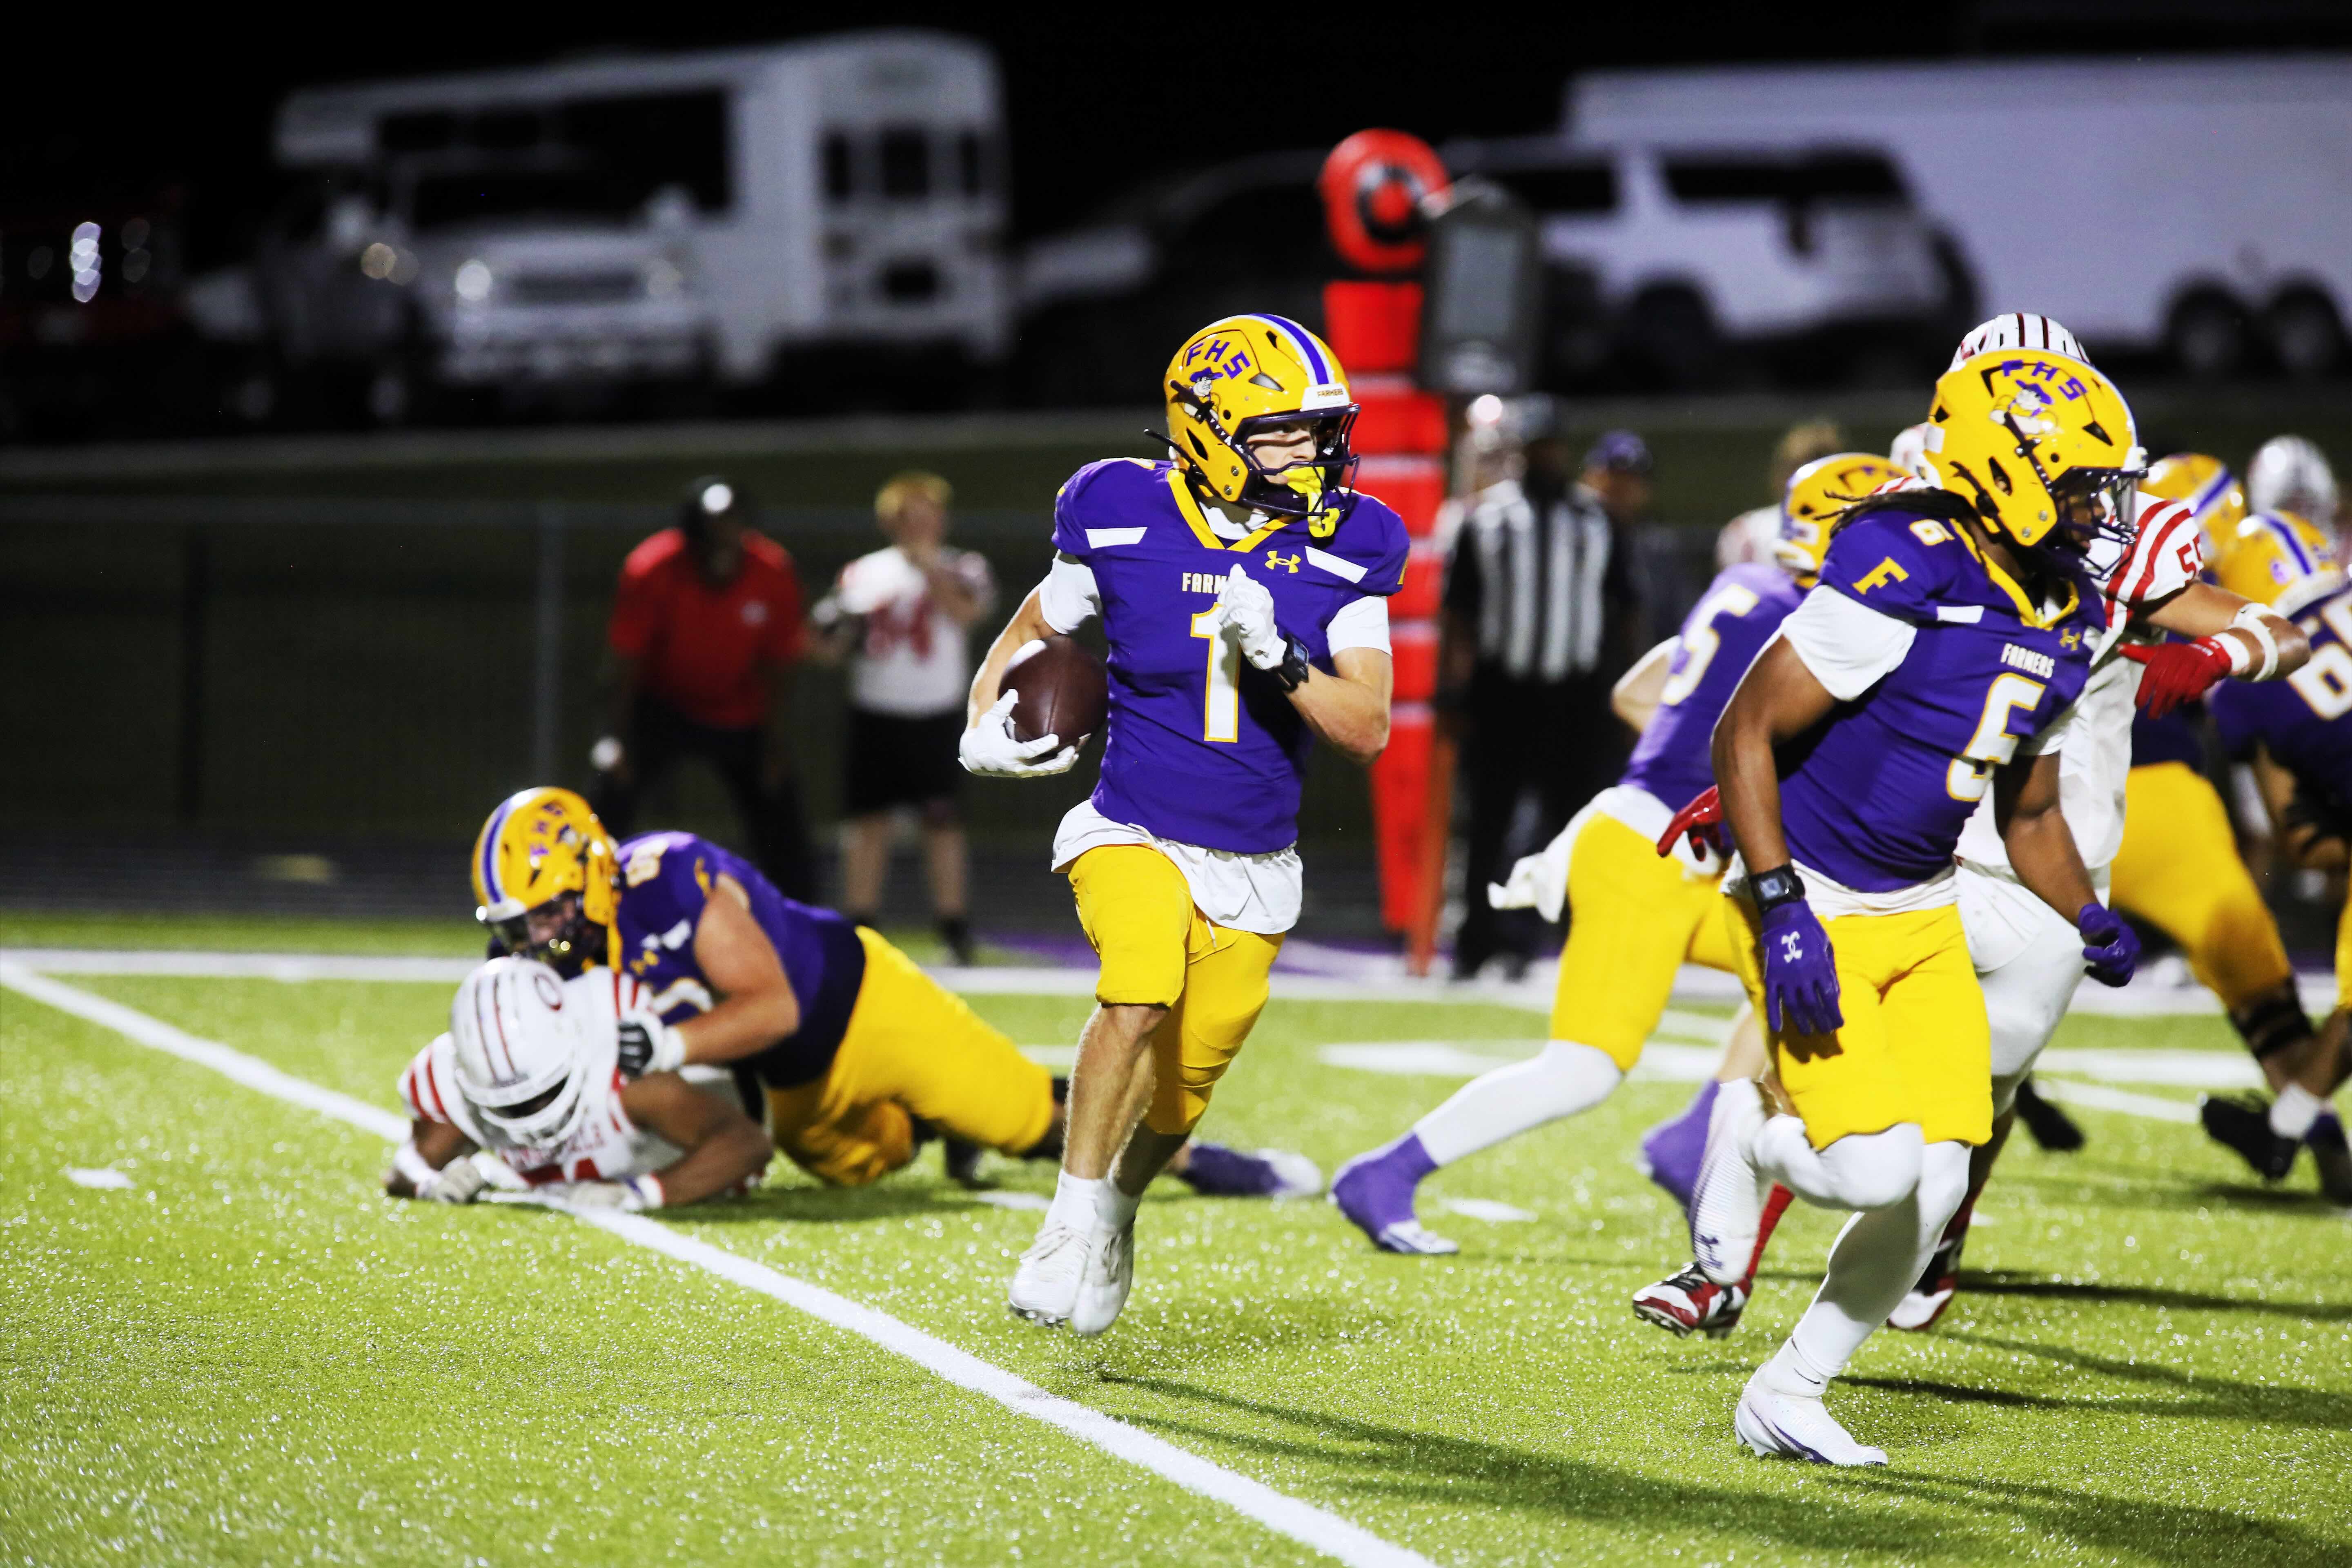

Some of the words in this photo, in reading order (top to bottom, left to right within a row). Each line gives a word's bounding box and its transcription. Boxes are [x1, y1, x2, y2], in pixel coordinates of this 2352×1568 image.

[1185, 339, 1251, 379] FHS
[2002, 359, 2088, 401] FHS
[1909, 518, 1955, 546] 6
[1852, 556, 1910, 595] F
[1190, 601, 1241, 743] 1
[2000, 642, 2055, 679] FARMERS
